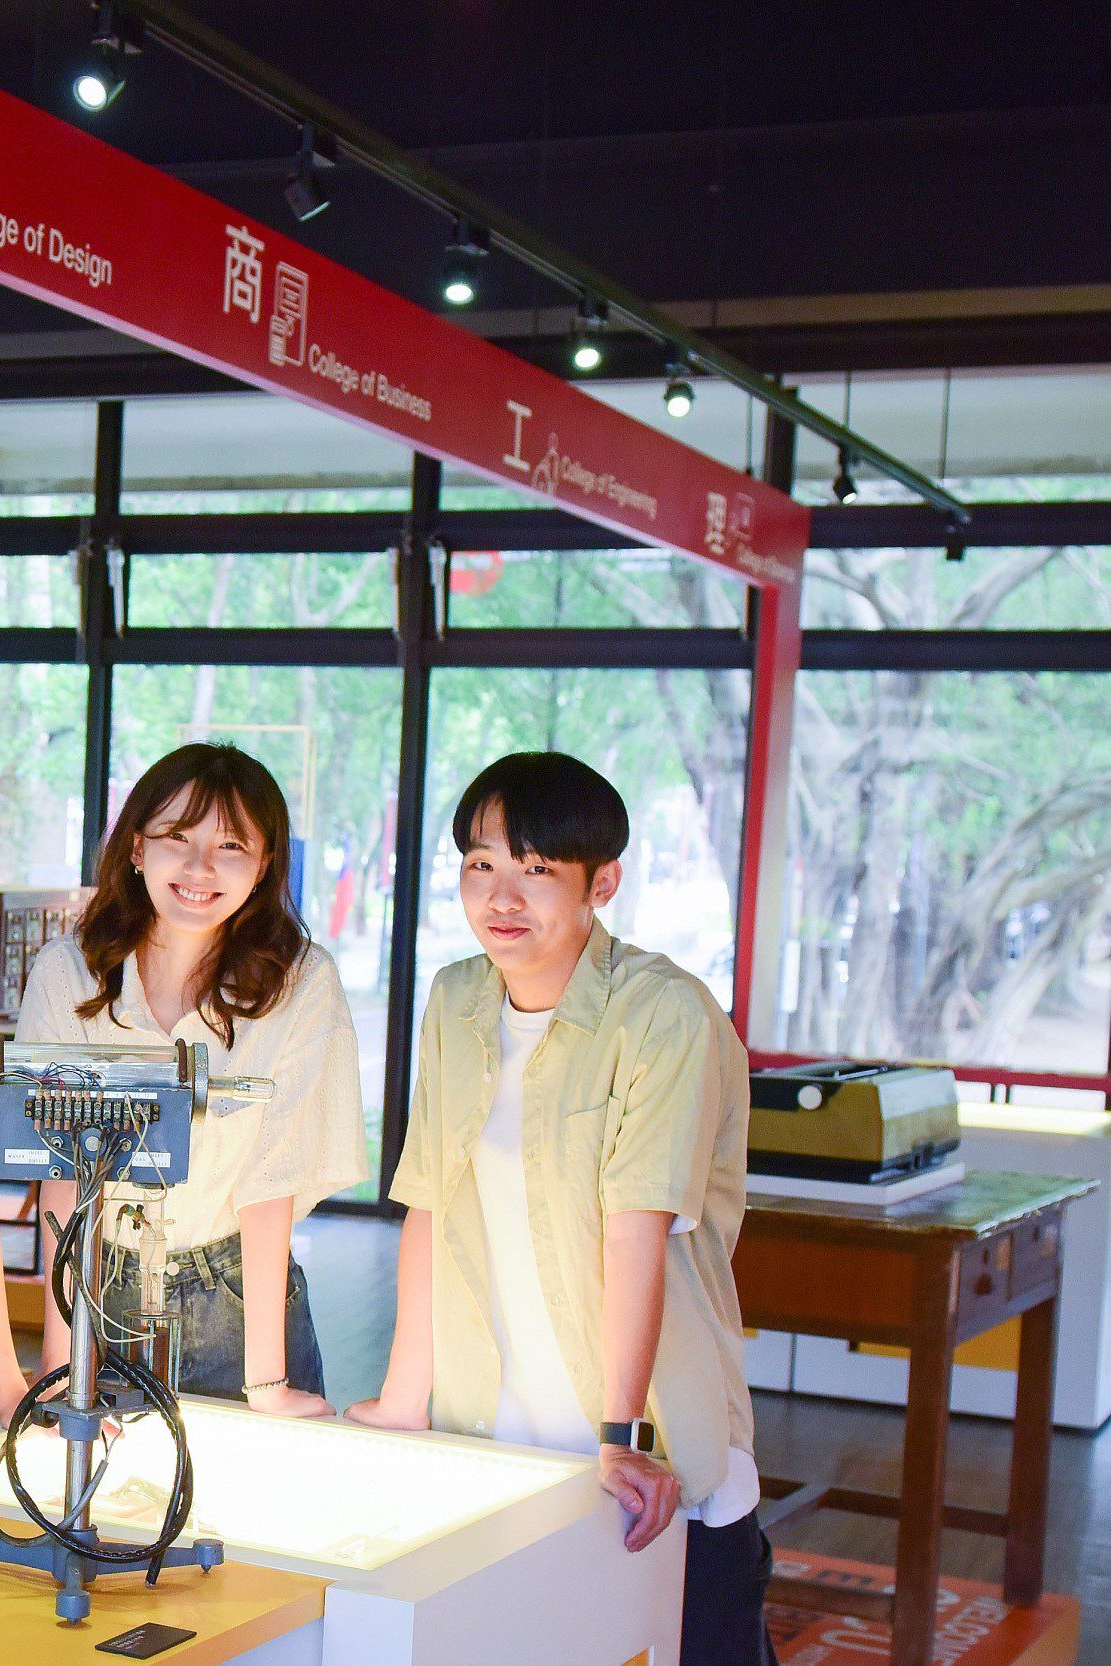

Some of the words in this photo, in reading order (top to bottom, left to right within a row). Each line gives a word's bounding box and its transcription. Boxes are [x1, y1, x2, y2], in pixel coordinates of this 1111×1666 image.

[23, 222, 45, 255] of
[48, 228, 113, 287] Design
[223, 224, 265, 324] 商
[308, 343, 360, 394] College
[360, 370, 377, 397] of
[376, 373, 432, 422] Business
[502, 399, 533, 473] 工
